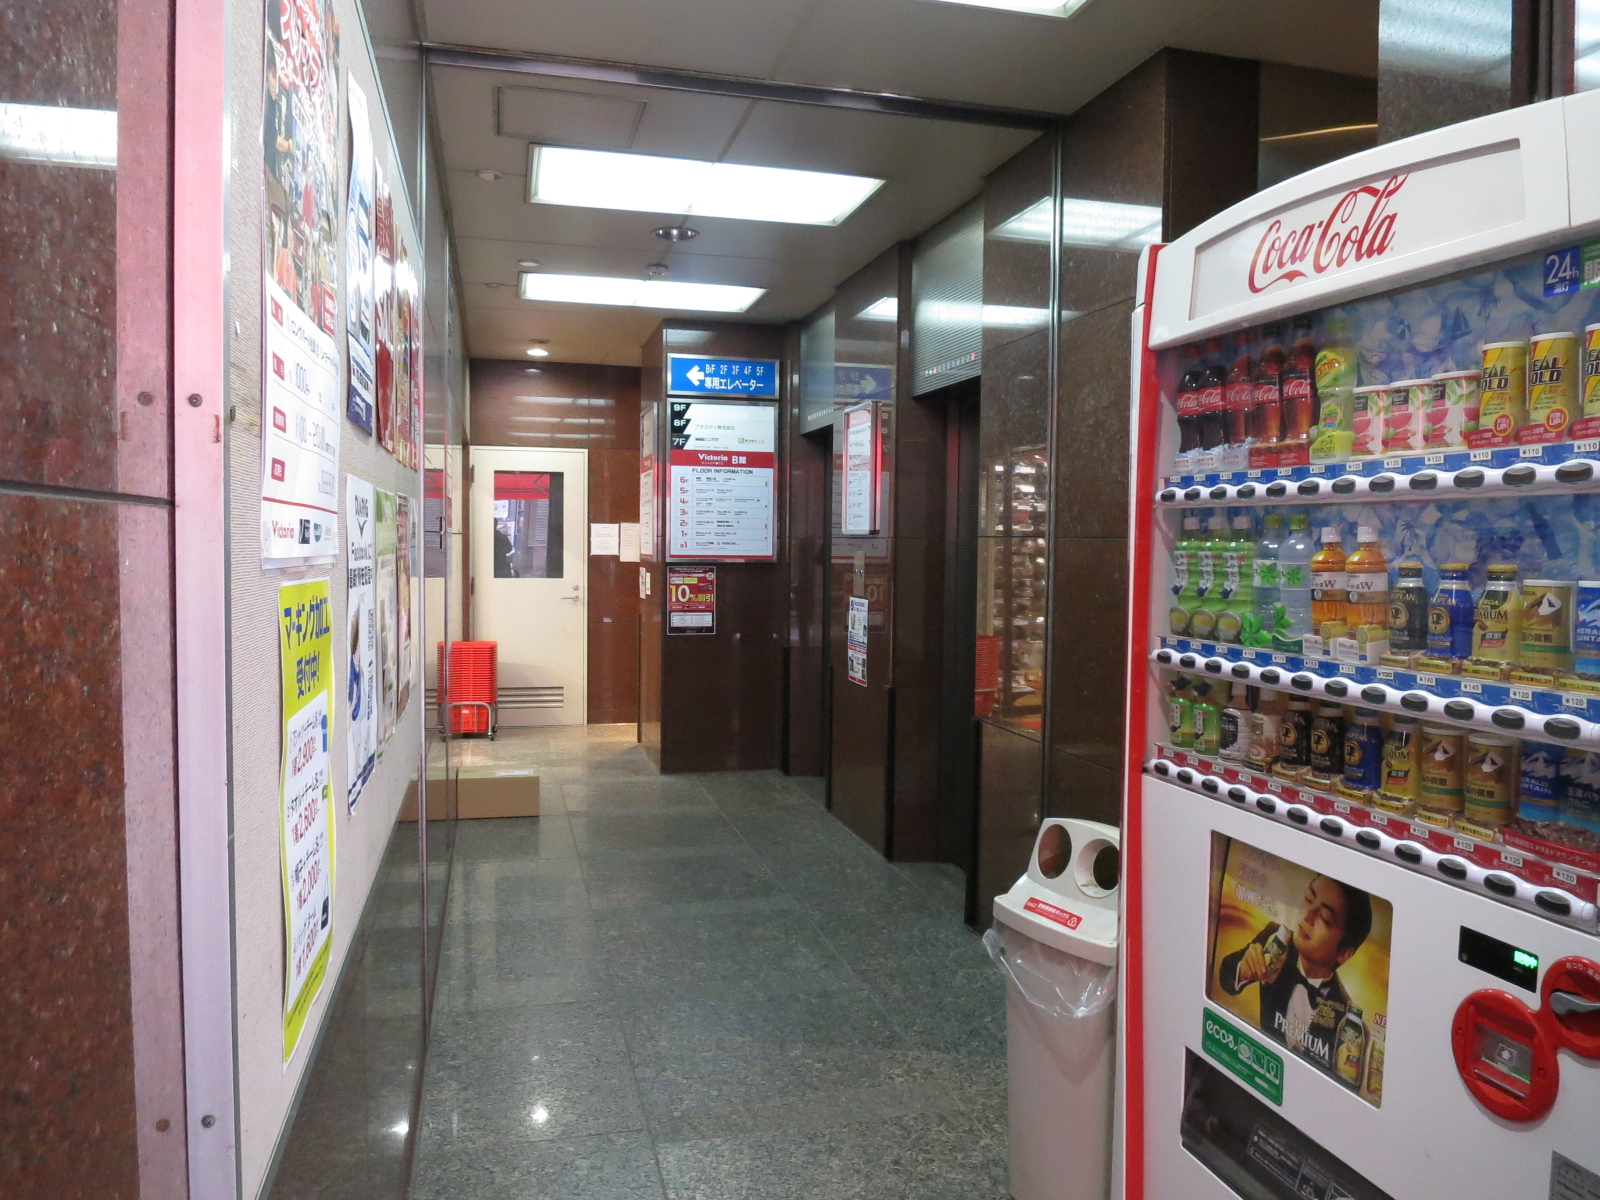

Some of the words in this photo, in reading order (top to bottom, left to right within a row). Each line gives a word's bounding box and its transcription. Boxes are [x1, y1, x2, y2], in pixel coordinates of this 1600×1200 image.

[719, 364, 728, 375] 2F
[731, 365, 740, 376] 3F
[743, 366, 752, 376] 4F
[756, 366, 764, 377] 5F
[704, 377, 764, 391] 専用エレベーター
[673, 404, 687, 412] 9F
[673, 419, 687, 427] 8F
[672, 437, 686, 446] 7F
[1576, 443, 1598, 451] ¥110
[698, 453, 728, 462] Victoria
[680, 508, 689, 516] 3F
[680, 519, 689, 527] 2F
[1418, 676, 1434, 684] ¥140
[1463, 683, 1480, 691] ¥140
[1512, 691, 1530, 699] ¥120
[1565, 697, 1584, 707] ¥120
[1456, 840, 1472, 850] ¥120
[1503, 855, 1521, 865] ¥120
[1555, 871, 1575, 883] ¥120
[1273, 1011, 1330, 1062] PREMIUM
